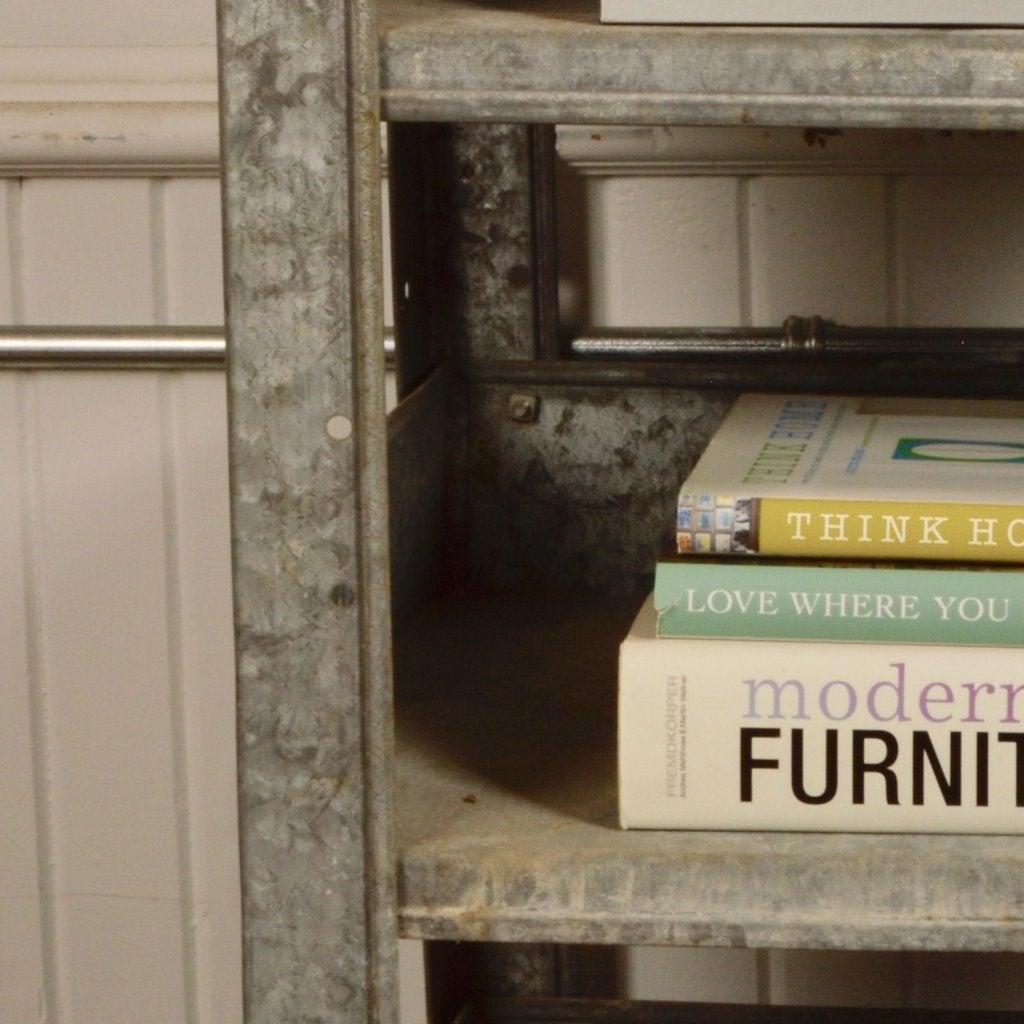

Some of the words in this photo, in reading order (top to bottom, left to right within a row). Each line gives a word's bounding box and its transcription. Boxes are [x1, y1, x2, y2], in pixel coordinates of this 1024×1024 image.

[787, 512, 949, 545] THINK
[687, 589, 778, 615] LOVE
[790, 592, 920, 619] WHERE
[934, 597, 1010, 622] YOU
